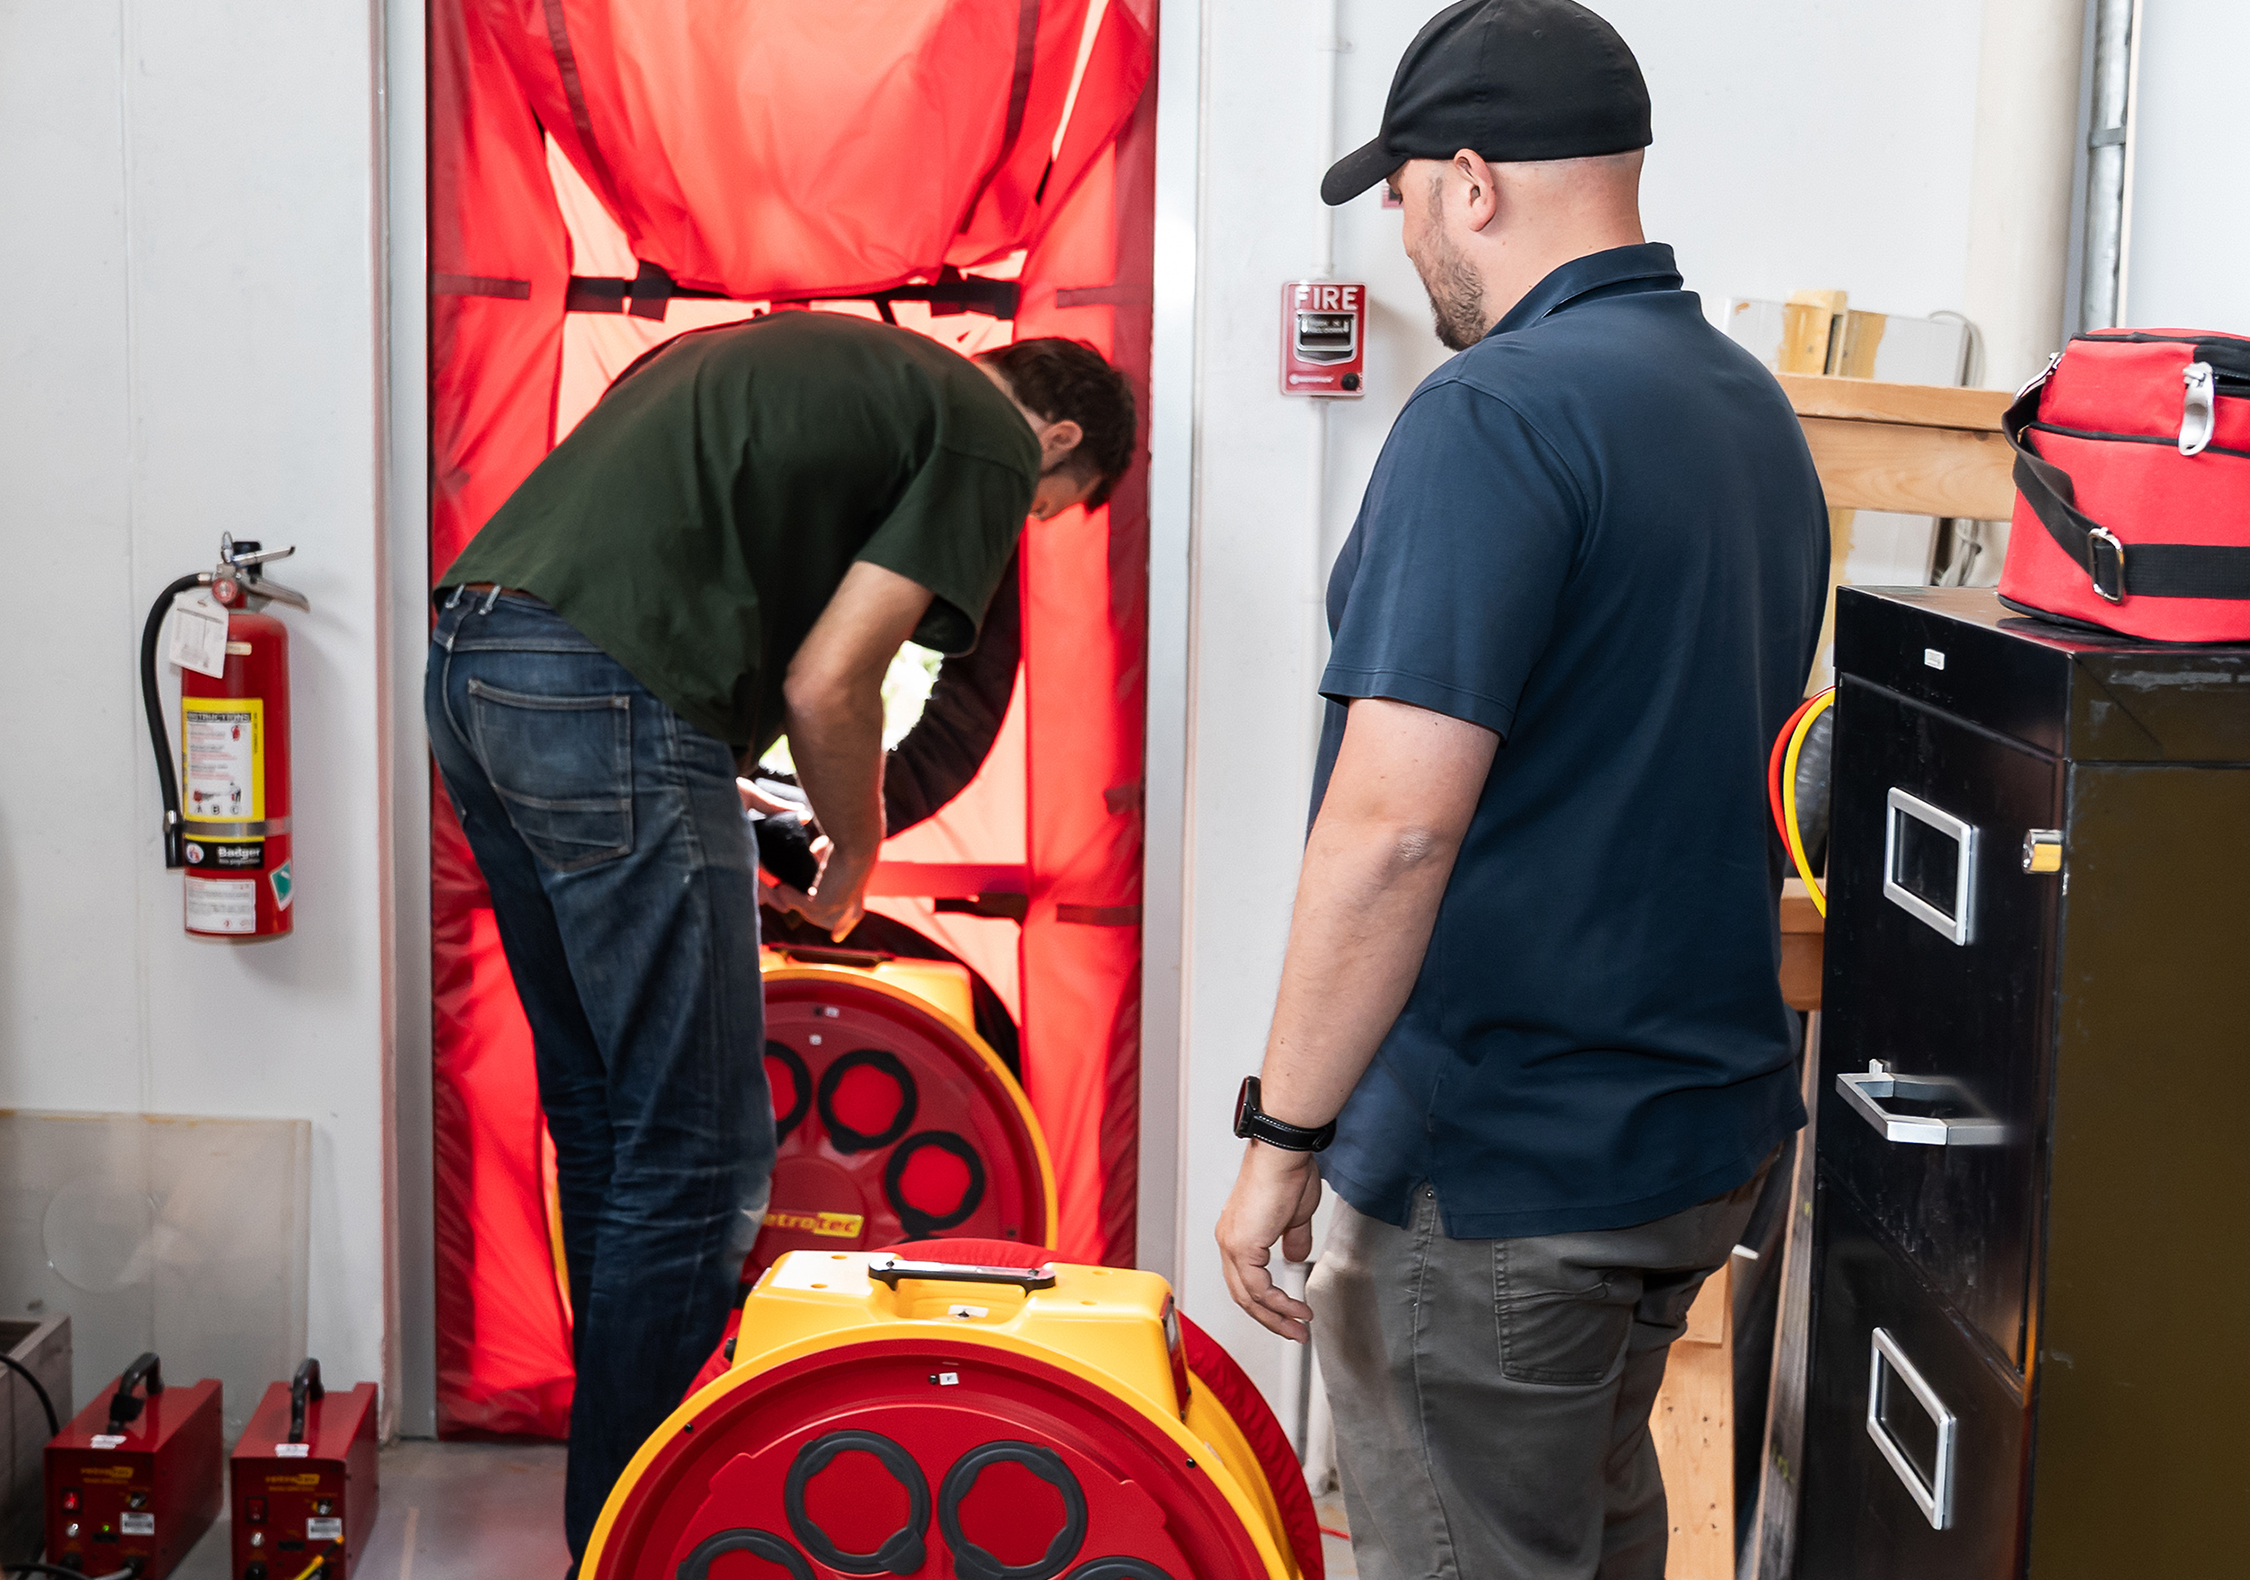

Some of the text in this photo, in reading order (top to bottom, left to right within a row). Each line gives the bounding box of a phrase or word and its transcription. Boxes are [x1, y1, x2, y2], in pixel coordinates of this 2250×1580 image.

[1294, 286, 1359, 310] FIRE
[218, 846, 261, 860] Badger
[762, 1212, 858, 1234] etrotec
